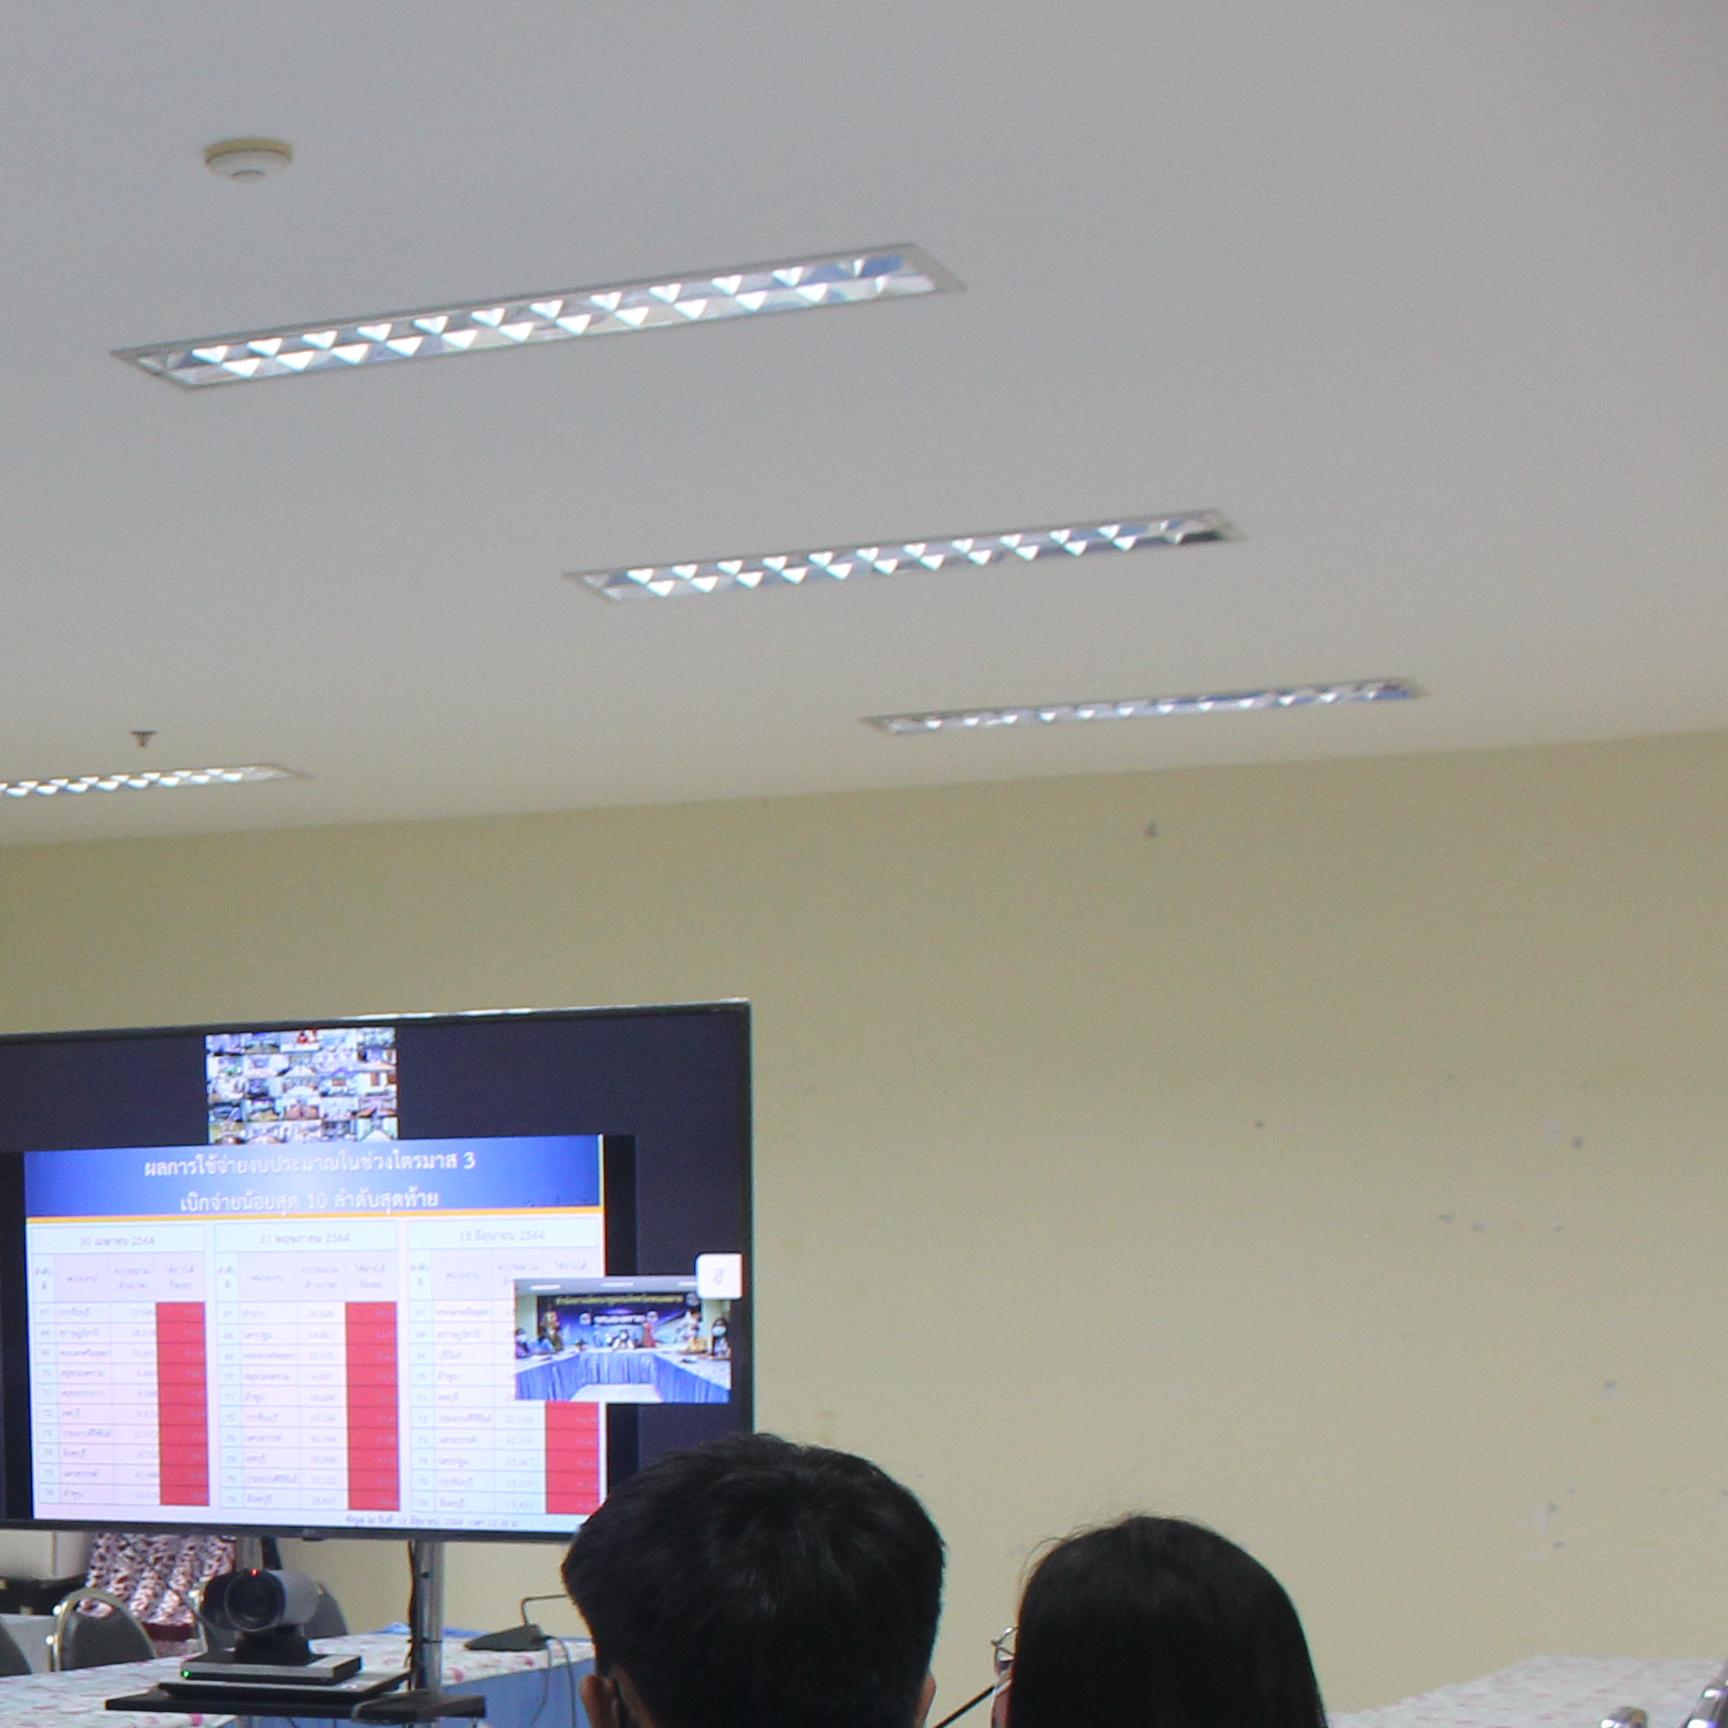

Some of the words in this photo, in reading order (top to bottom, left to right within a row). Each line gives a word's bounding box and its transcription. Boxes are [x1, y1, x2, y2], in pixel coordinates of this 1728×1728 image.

[463, 1151, 476, 1170] 3
[180, 1189, 298, 1217] เบิกจ่ายน้อยสุด
[307, 1193, 328, 1210] 10
[334, 1185, 439, 1215] ลำดับสุดท้าย
